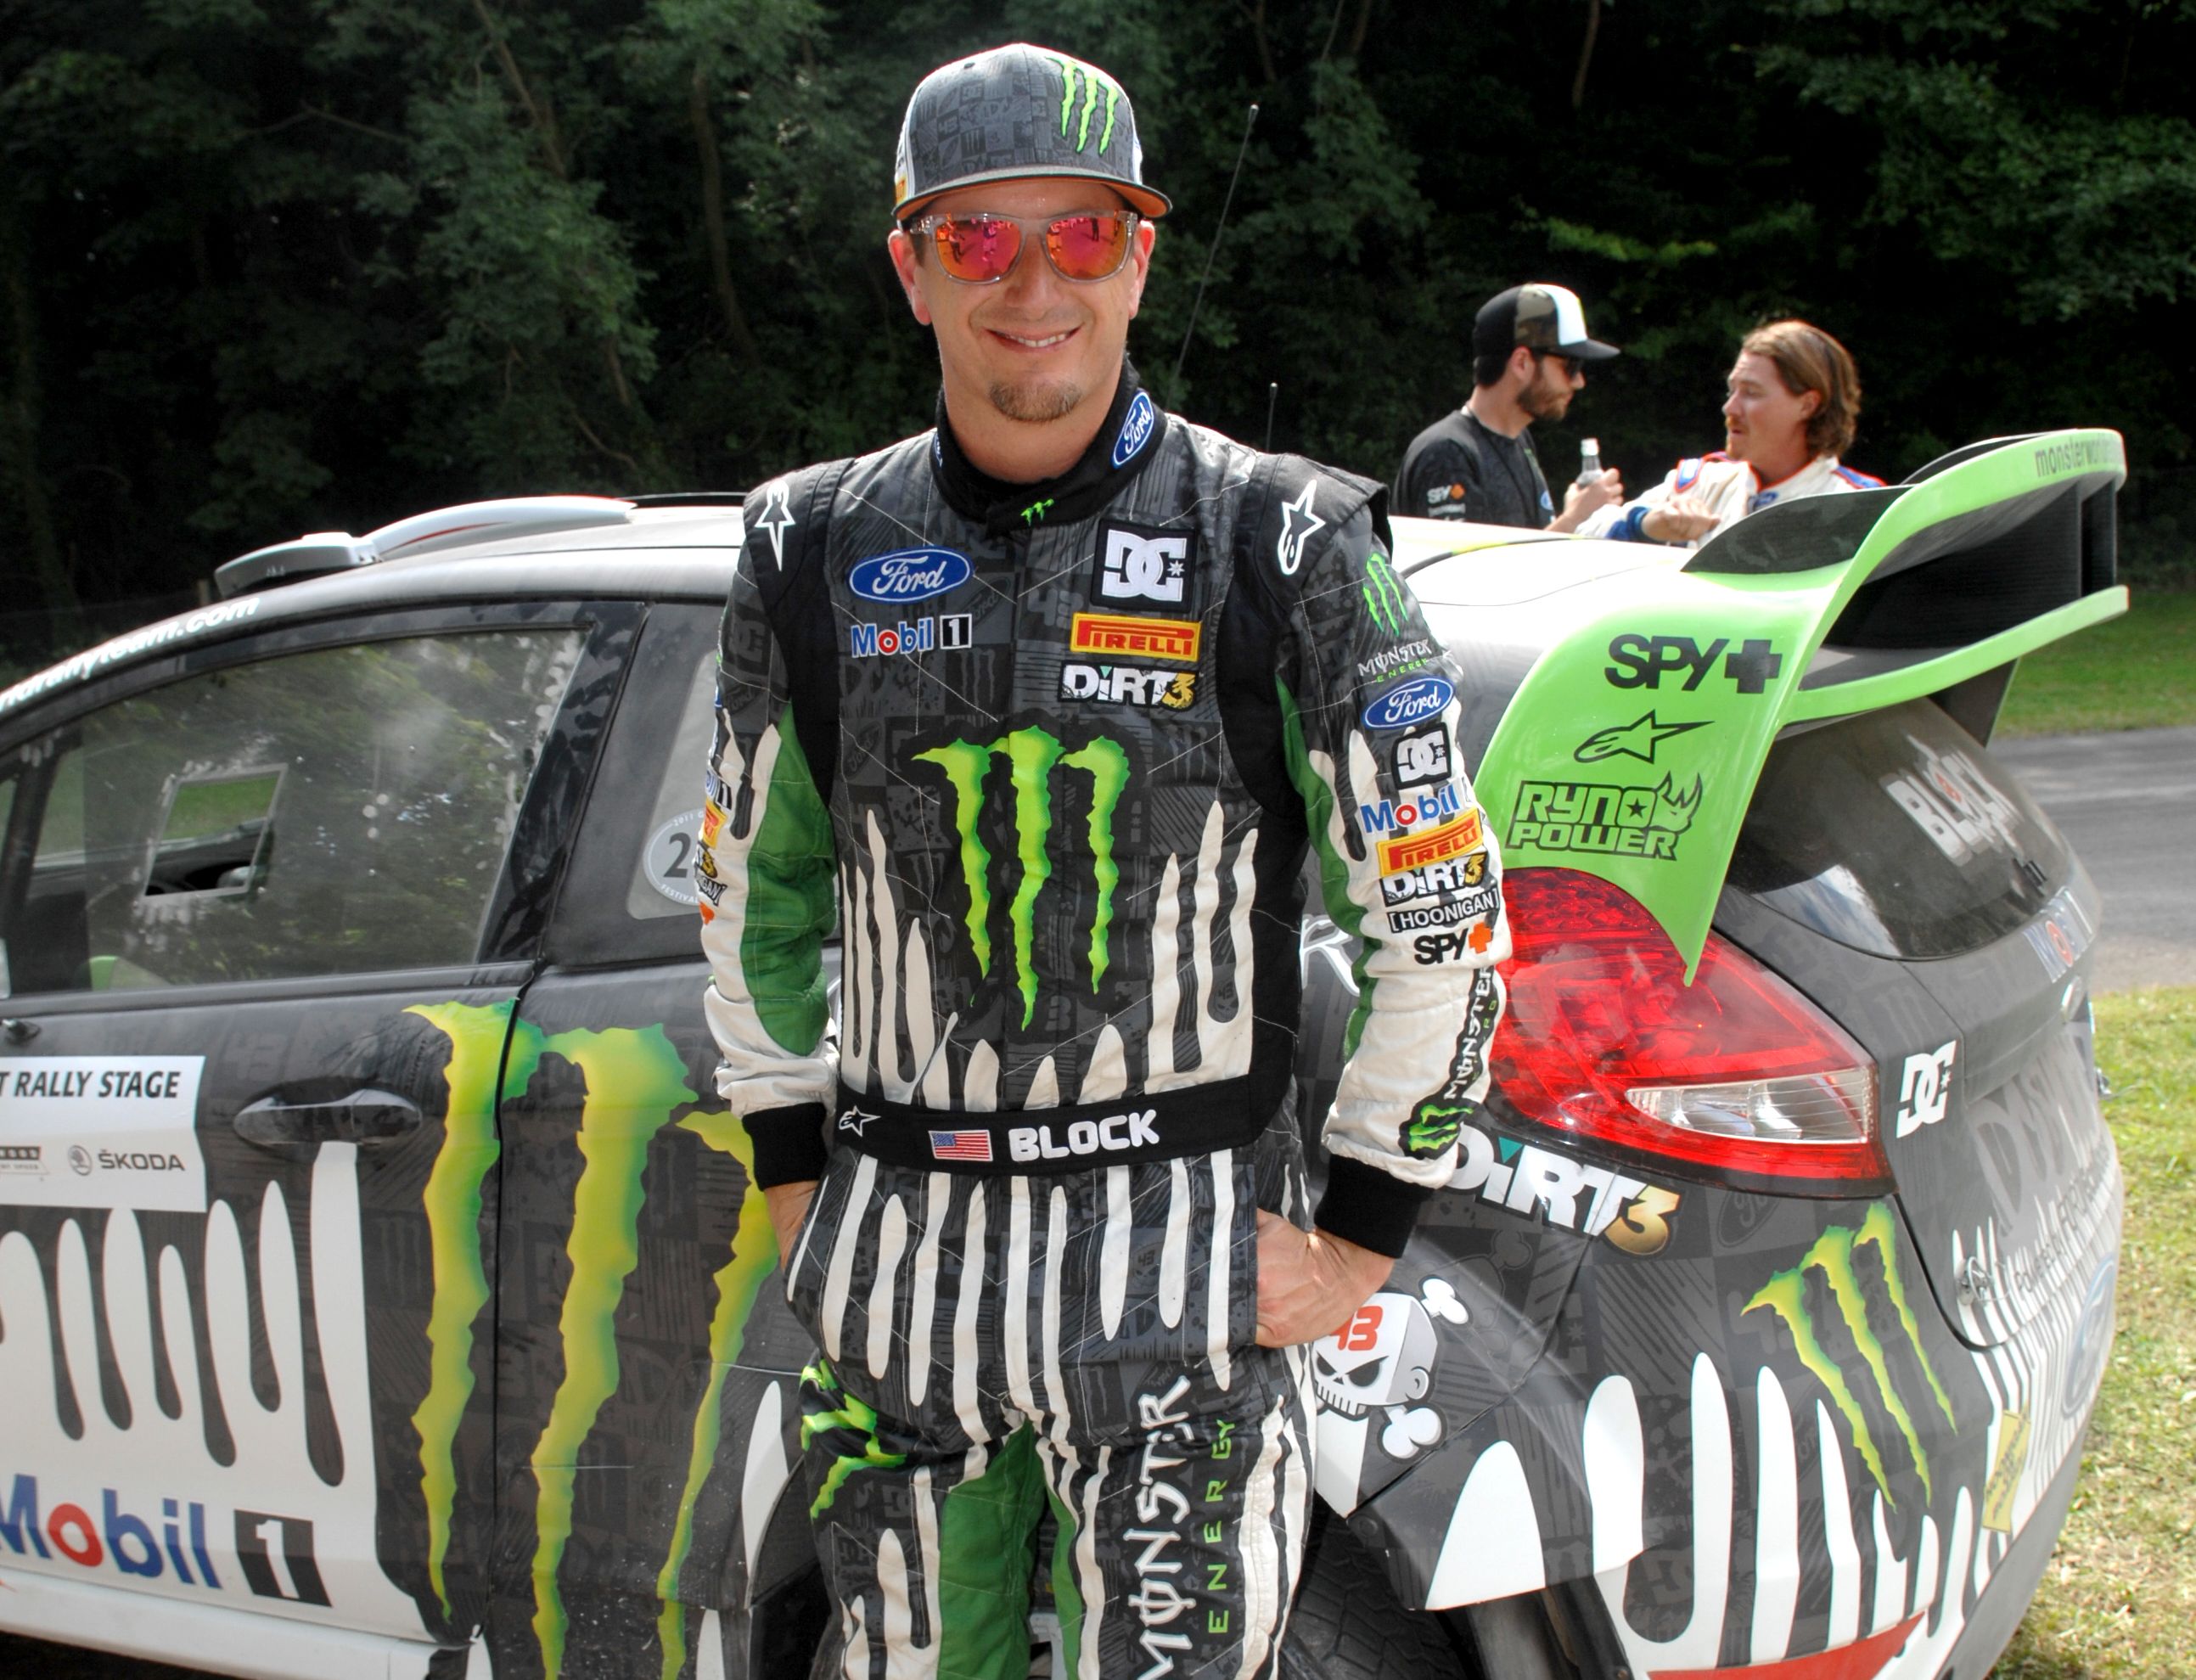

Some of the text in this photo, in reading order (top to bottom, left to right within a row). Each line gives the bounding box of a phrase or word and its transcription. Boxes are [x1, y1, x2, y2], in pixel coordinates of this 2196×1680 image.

[1121, 399, 1153, 455] Ford
[871, 554, 948, 595] Ford
[851, 617, 934, 658] Mobil
[1076, 619, 1196, 656] PIRELLI
[1357, 638, 1433, 677] MONSTER
[1376, 658, 1429, 683] ENERGY
[1384, 683, 1441, 722] Ford
[1360, 784, 1461, 834] Mobil
[1387, 817, 1480, 871] PIRELLI
[1505, 822, 1678, 862] POWER
[14, 1070, 93, 1098] RALLY
[98, 1070, 181, 1098] STAGE
[1008, 1109, 1160, 1162] BLOCK
[98, 1149, 186, 1172] ŠKODA
[0, 1473, 222, 1590] Mobil
[1204, 1419, 1236, 1634] ENERGY
